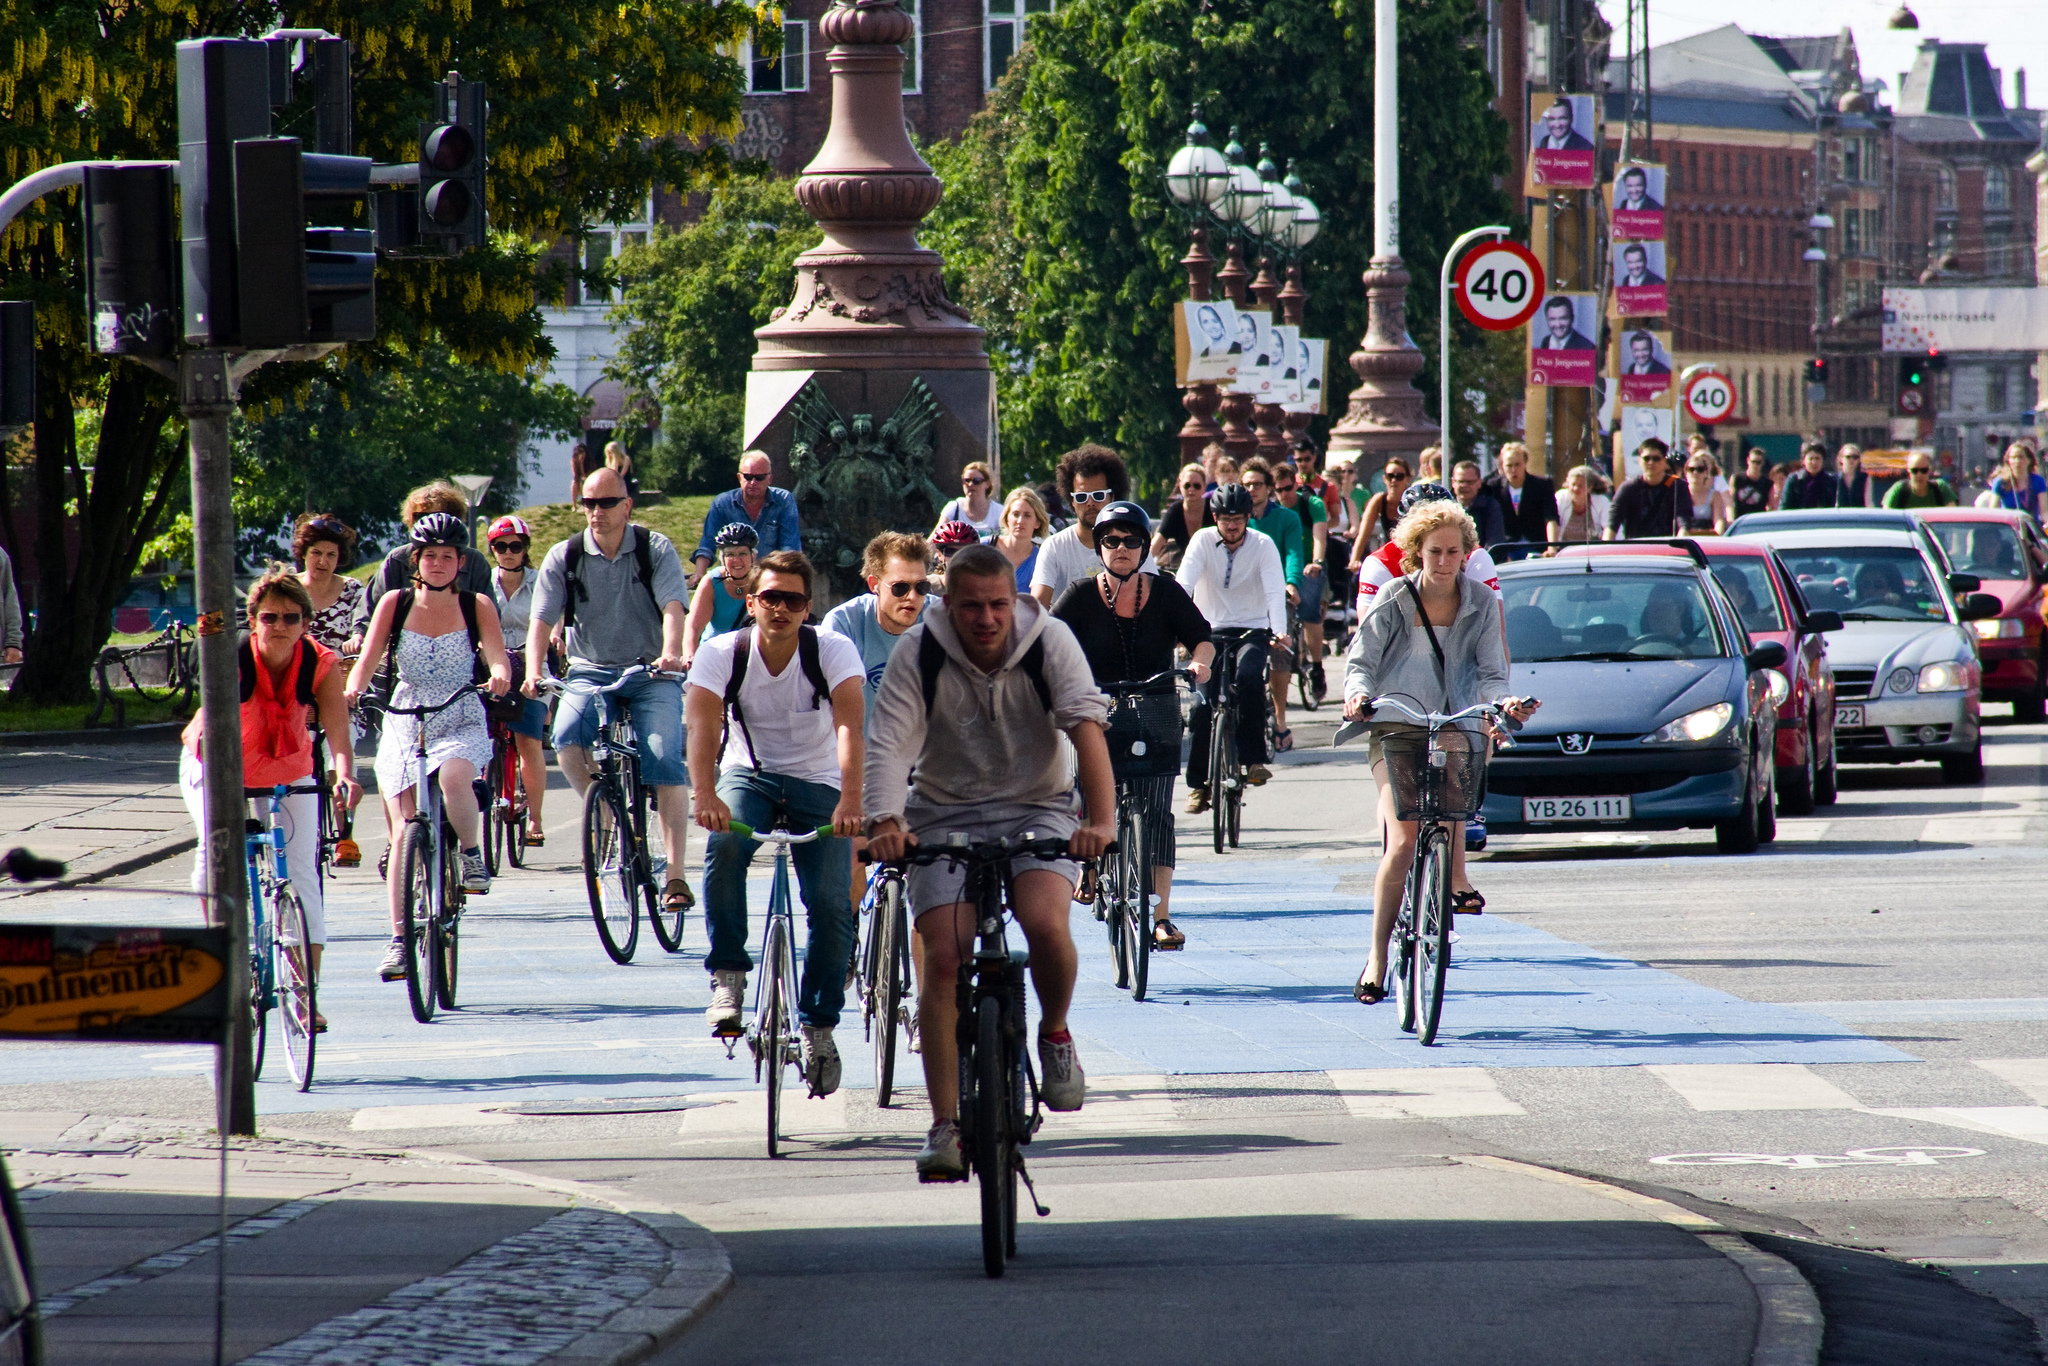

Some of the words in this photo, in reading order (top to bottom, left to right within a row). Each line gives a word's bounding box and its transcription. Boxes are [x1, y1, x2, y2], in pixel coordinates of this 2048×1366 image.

[1535, 157, 1551, 166] Dan
[1470, 269, 1528, 303] 40
[1536, 357, 1553, 366] Dan
[1693, 388, 1726, 409] 40
[1838, 710, 1860, 724] 22
[1528, 801, 1556, 817] YB
[1561, 800, 1586, 817] 26
[1592, 799, 1622, 816] 111
